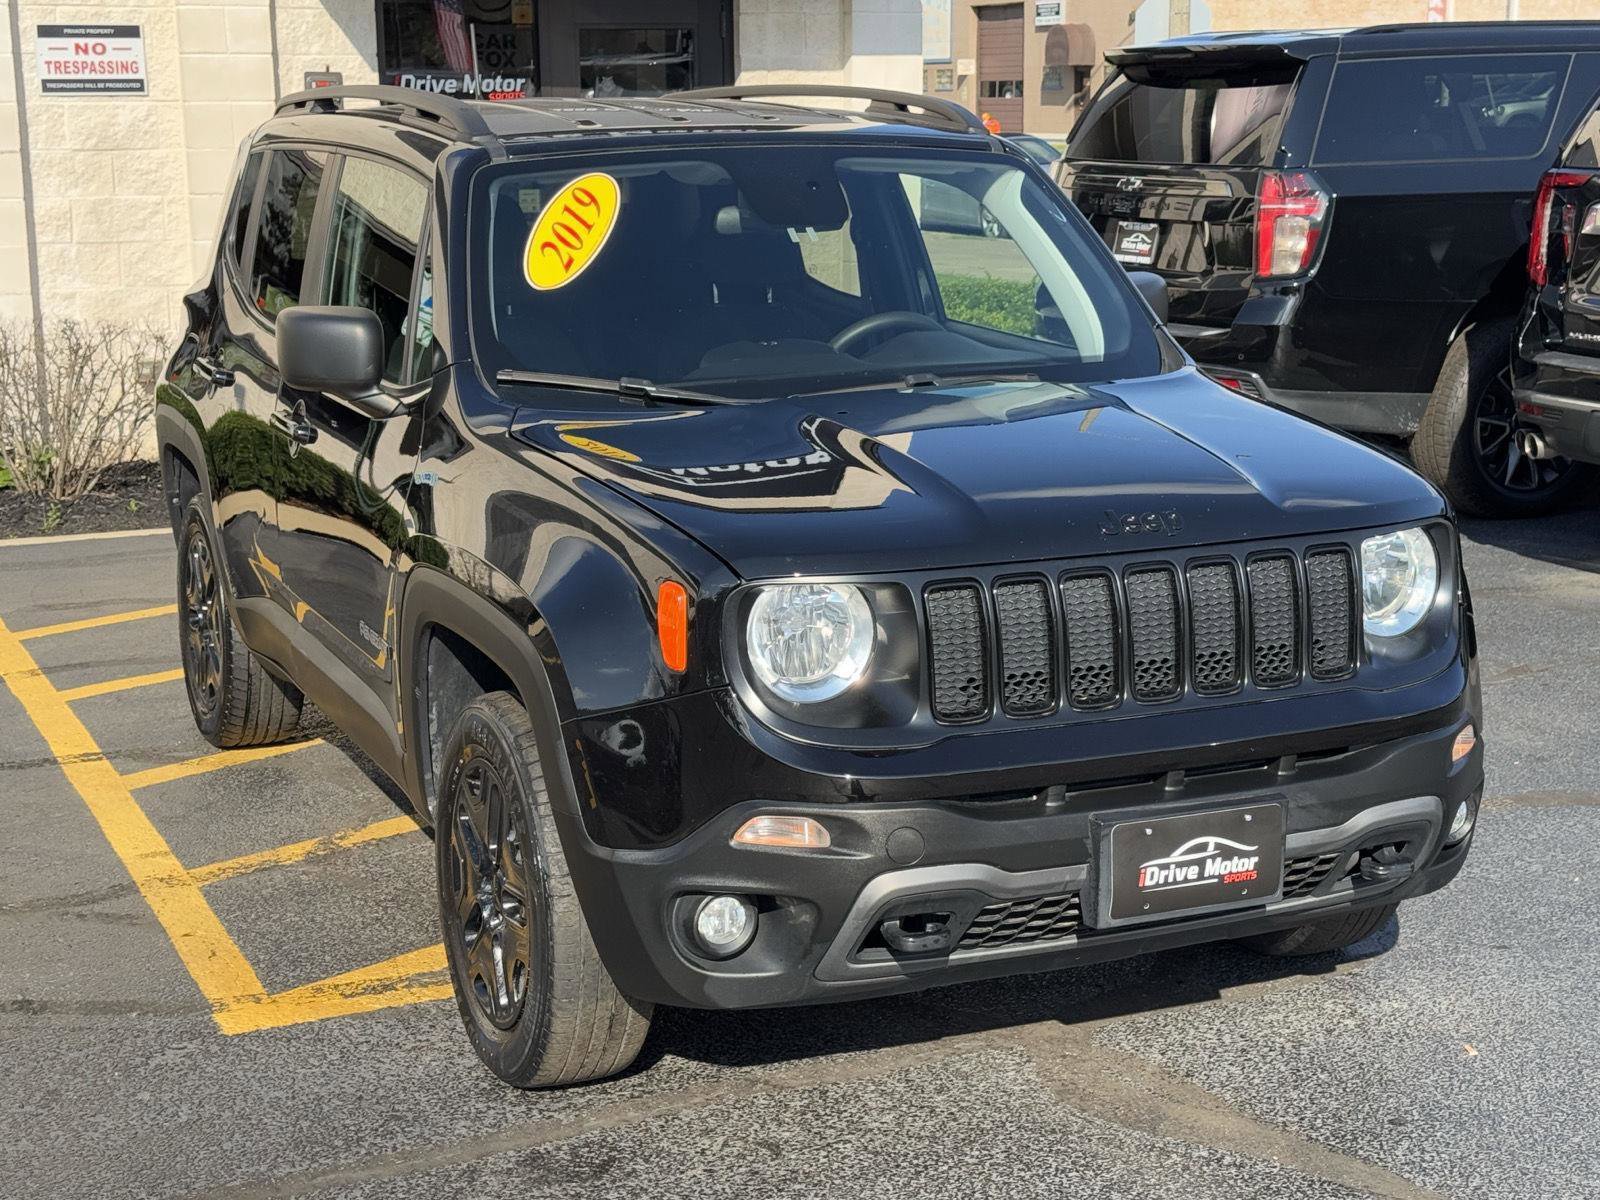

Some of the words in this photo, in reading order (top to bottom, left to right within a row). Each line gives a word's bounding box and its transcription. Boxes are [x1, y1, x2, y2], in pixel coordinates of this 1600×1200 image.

[74, 42, 107, 56] NO
[44, 60, 140, 75] TRESPASSING
[463, 73, 526, 94] Motor
[540, 187, 601, 274] 2019
[1098, 509, 1184, 537] Jeep
[1138, 863, 1199, 887] iDrive
[1204, 855, 1259, 878] Motor
[1223, 870, 1258, 884] SPORTS
